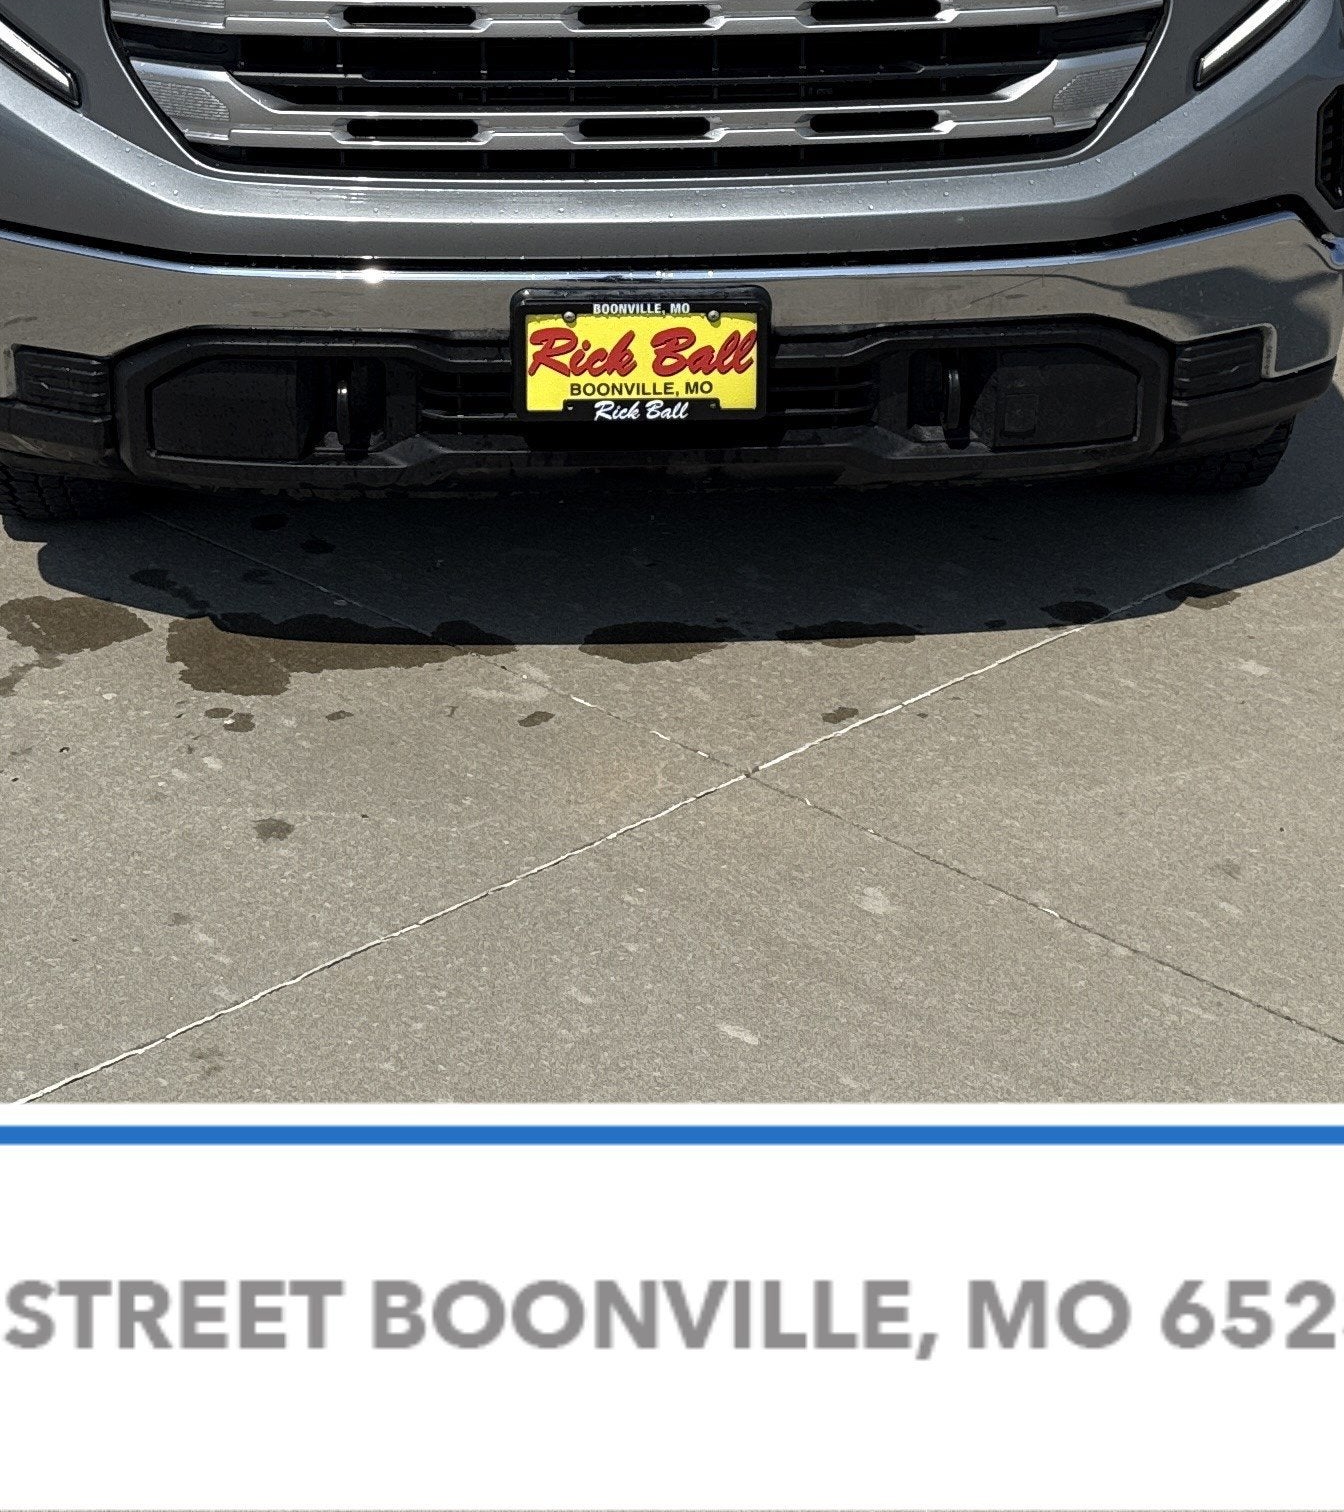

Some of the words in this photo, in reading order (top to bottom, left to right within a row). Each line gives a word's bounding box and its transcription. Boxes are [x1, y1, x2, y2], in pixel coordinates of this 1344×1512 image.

[592, 302, 666, 316] BOONVILLE,
[669, 302, 691, 314] MO
[528, 326, 638, 377] Rick
[651, 326, 757, 377] Ball
[569, 382, 680, 397] BOONVILLE,
[684, 381, 713, 395] MO
[594, 400, 642, 422] Rick
[645, 401, 689, 420] Ball
